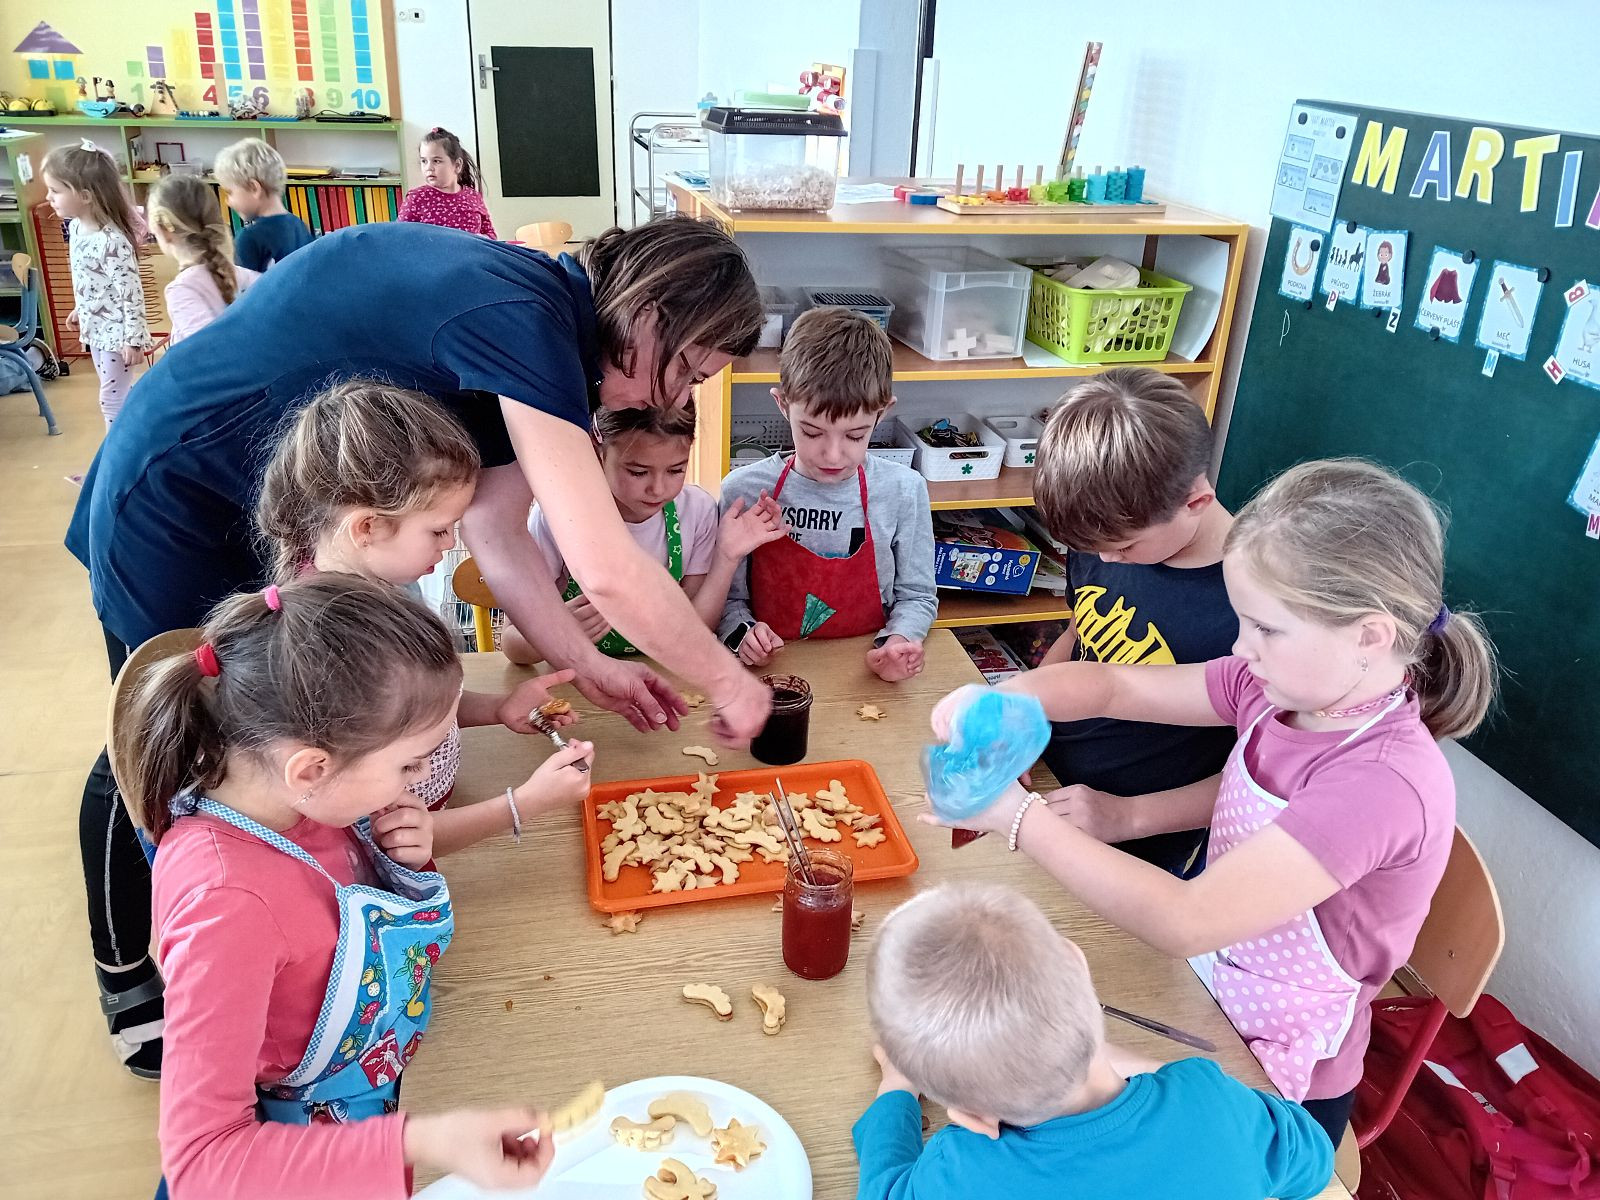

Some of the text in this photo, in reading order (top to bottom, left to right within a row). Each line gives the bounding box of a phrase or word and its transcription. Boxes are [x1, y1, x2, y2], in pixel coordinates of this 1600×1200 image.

[203, 85, 218, 105] 4
[252, 86, 269, 111] 6
[325, 88, 343, 109] 9
[351, 88, 380, 110] 10
[1352, 120, 1600, 230] MARTI
[1328, 290, 1337, 305] P
[1568, 286, 1585, 303] B
[1389, 311, 1399, 328] Z
[1572, 357, 1592, 370] HUSA
